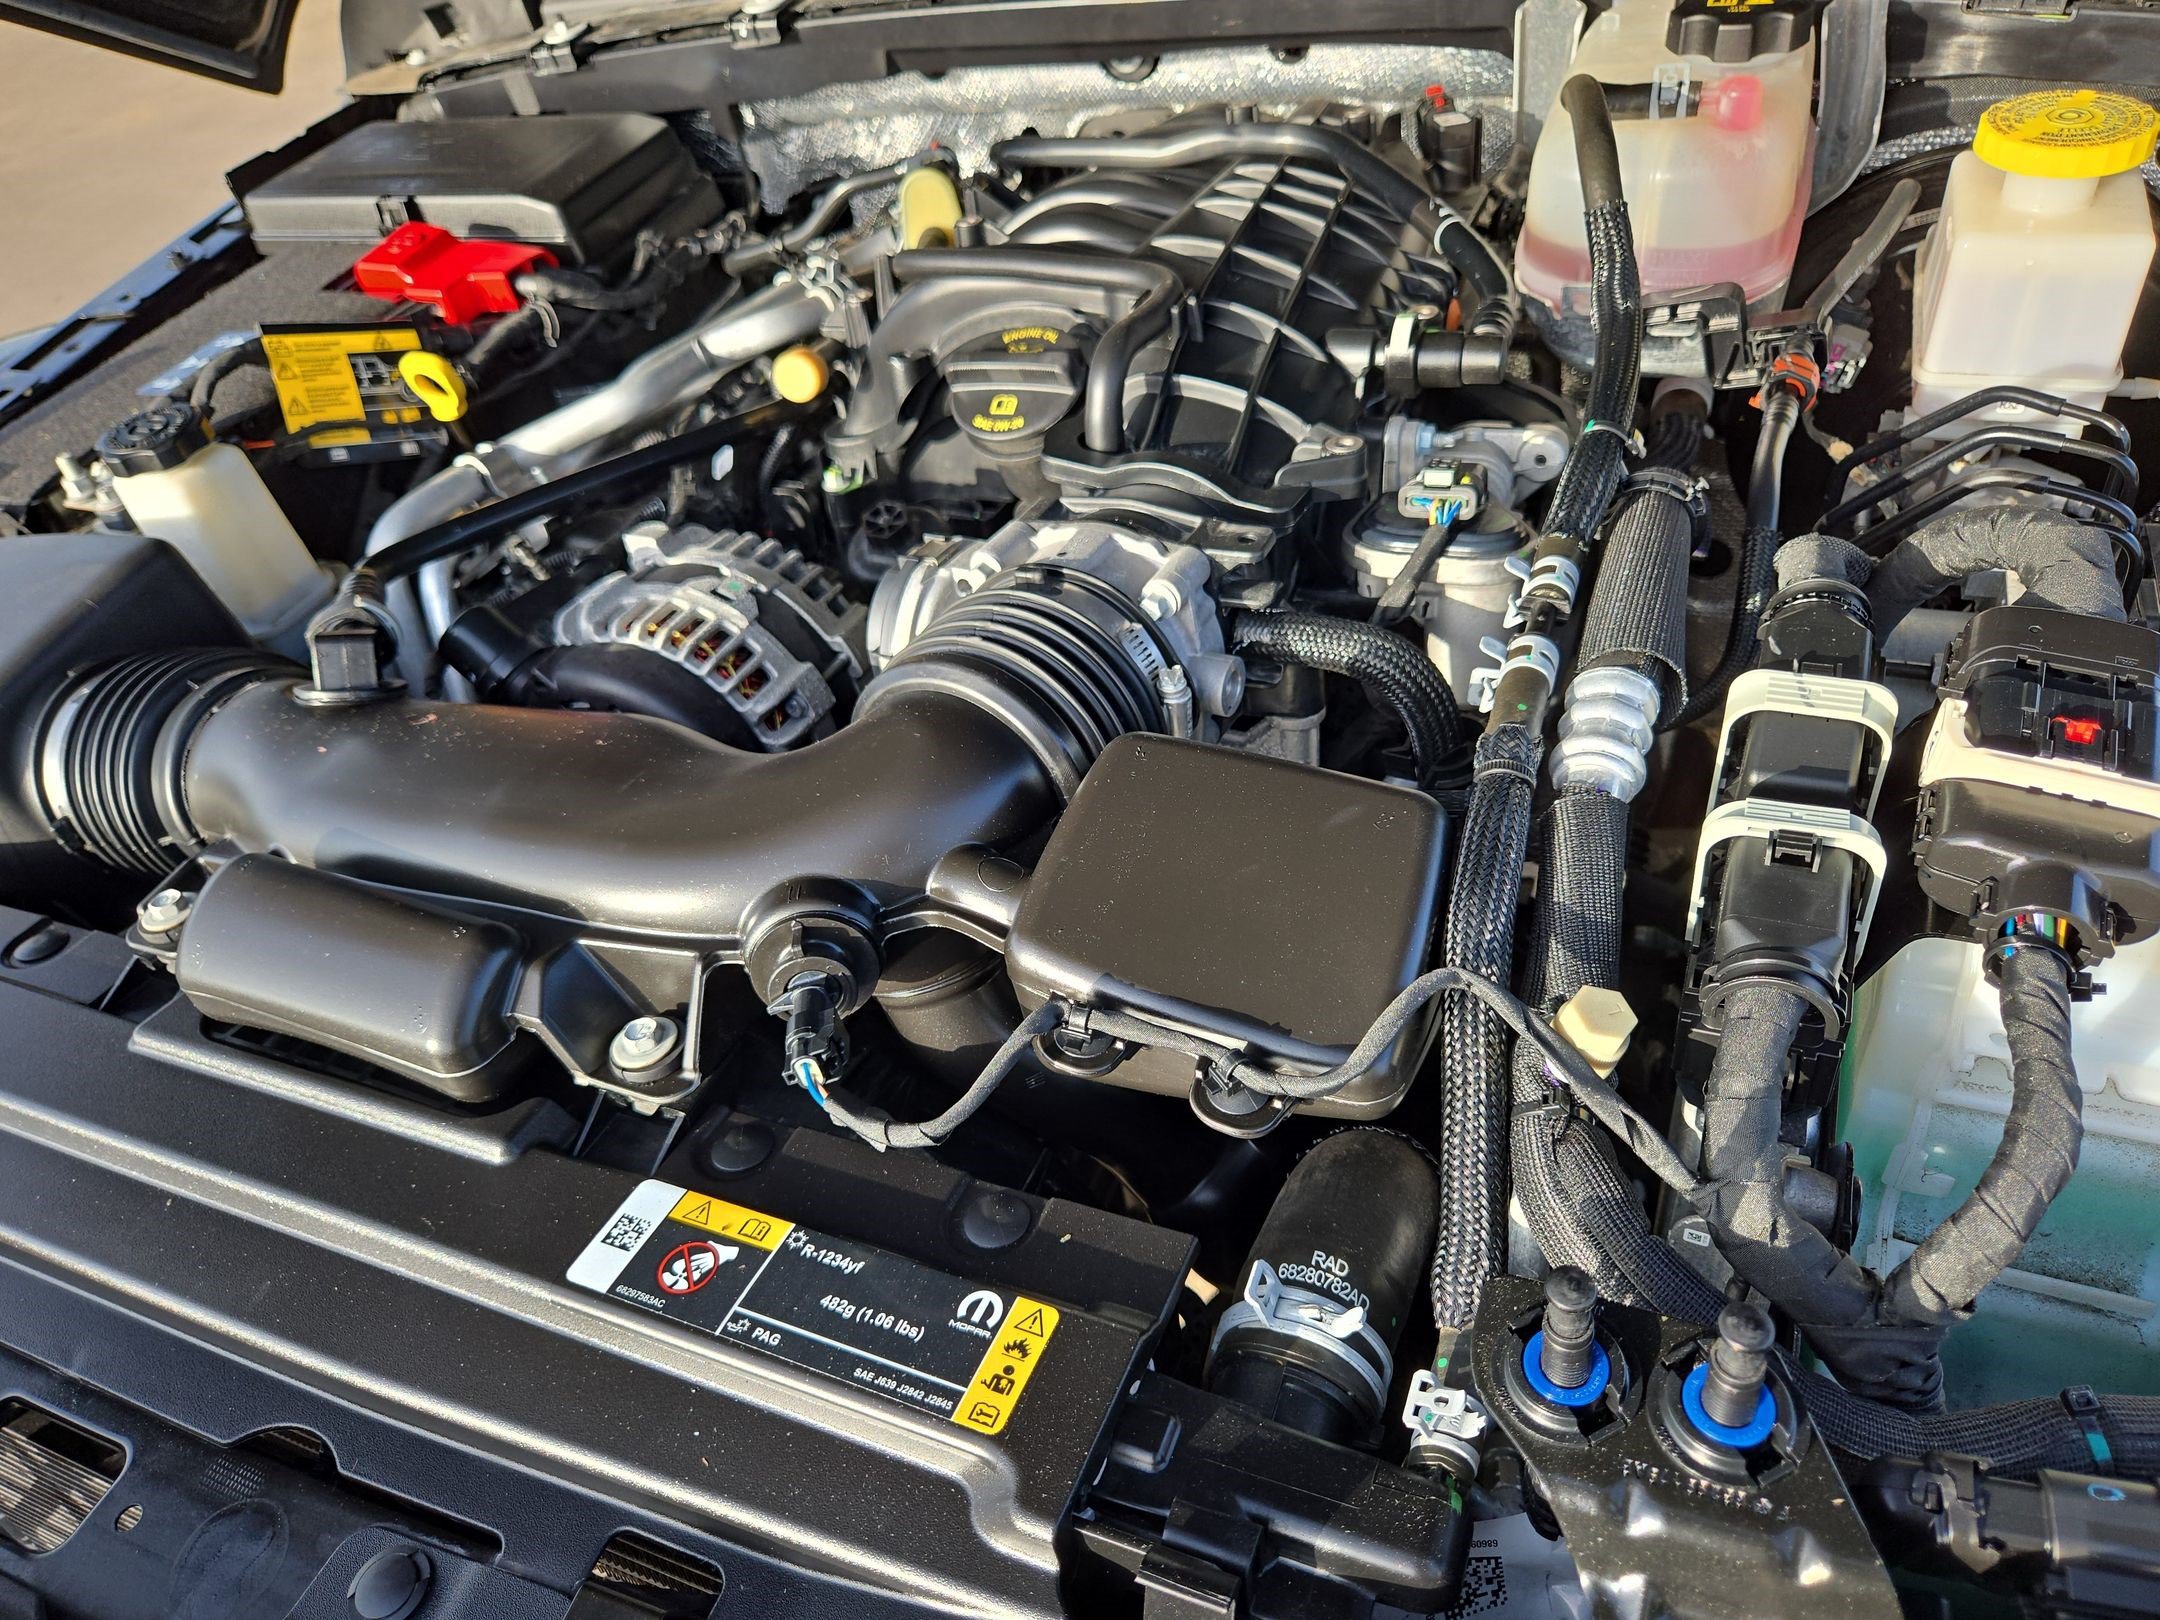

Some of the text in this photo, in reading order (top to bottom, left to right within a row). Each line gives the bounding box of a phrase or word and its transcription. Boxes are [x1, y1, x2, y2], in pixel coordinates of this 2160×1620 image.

[1002, 327, 1059, 345] ENGINE OIL
[972, 414, 994, 431] SAE
[800, 1243, 865, 1275] R-1234yf
[1311, 1250, 1349, 1277] RAD
[615, 1284, 666, 1308] 68297583AC
[1278, 1263, 1370, 1311] 68280782AD
[820, 1294, 925, 1343] 482g (1.06 lbs)
[752, 1327, 782, 1346] PAG
[854, 1368, 954, 1410] SAE J639 J2842 J2845
